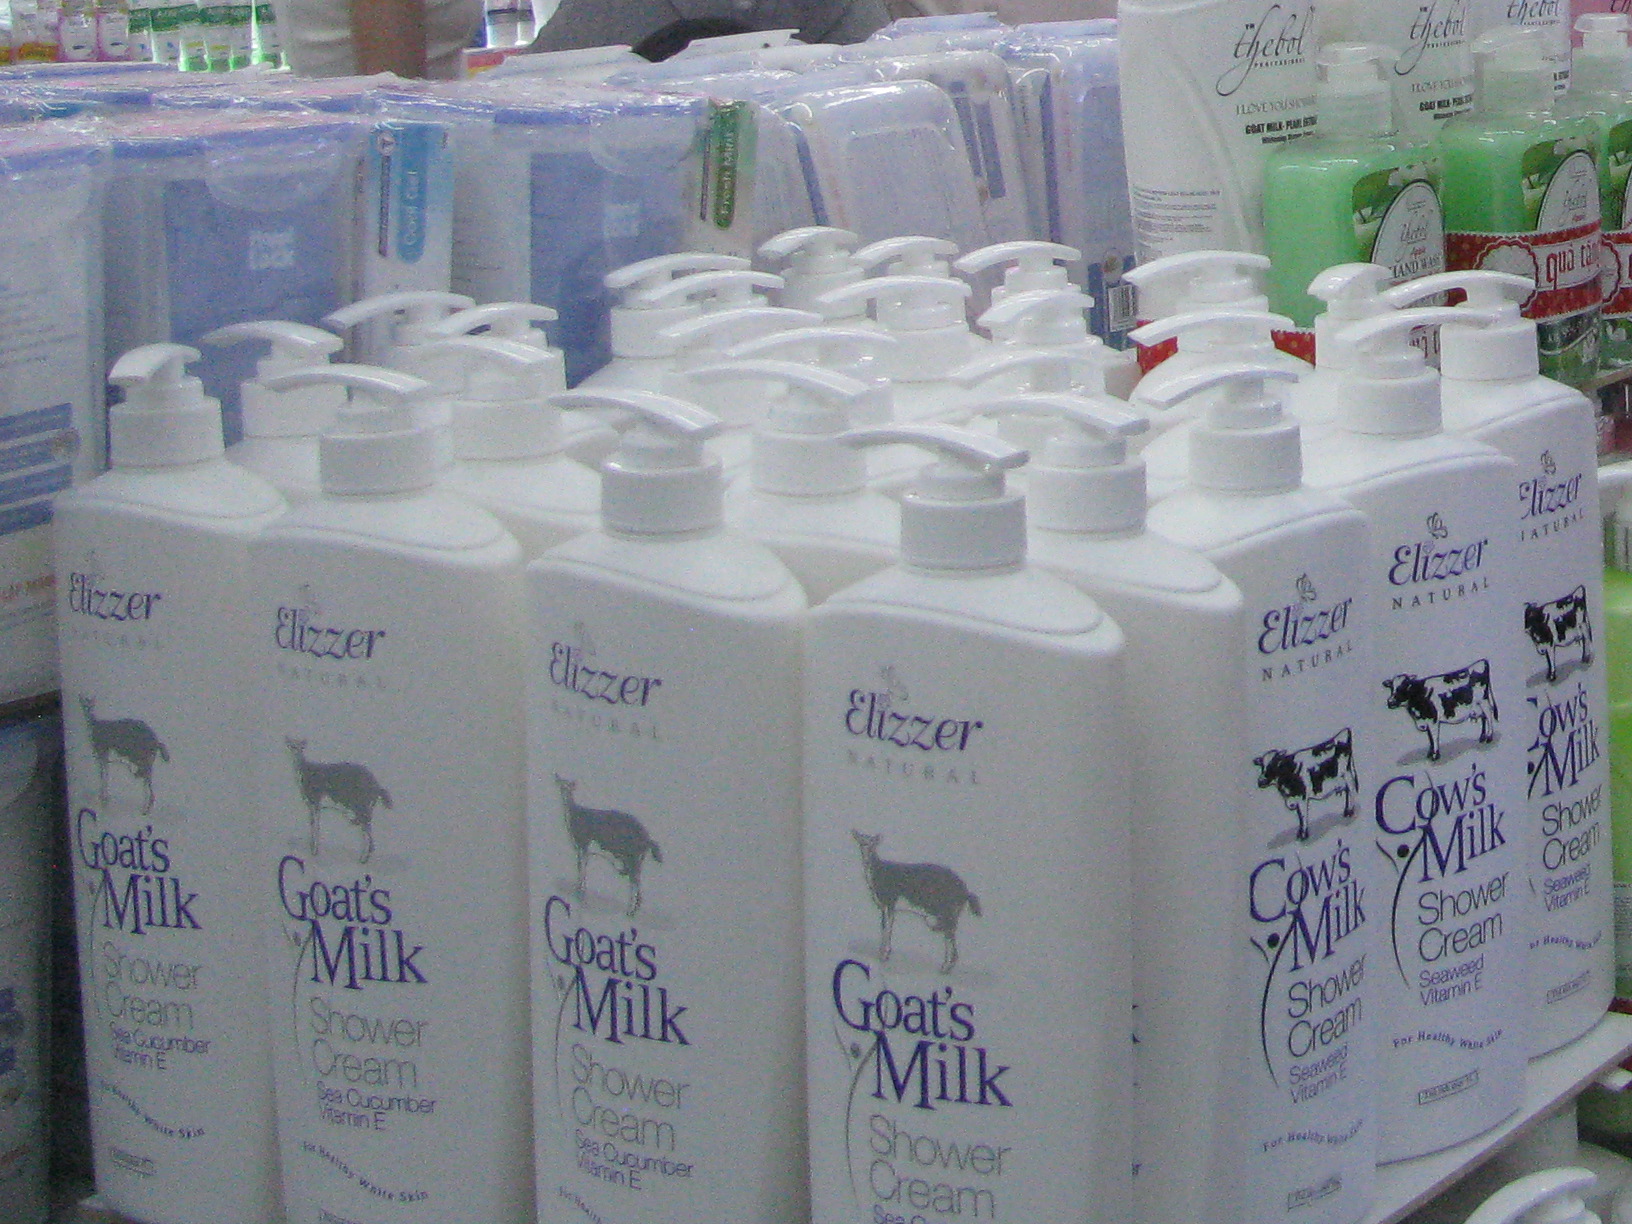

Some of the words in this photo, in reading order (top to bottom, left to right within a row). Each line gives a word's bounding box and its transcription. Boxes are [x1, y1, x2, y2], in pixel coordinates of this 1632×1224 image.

[1386, 534, 1490, 588] Elizzer
[69, 572, 163, 622] Elizzer
[1256, 591, 1355, 657] Elizzer
[1390, 575, 1491, 612] NATURAL
[275, 605, 386, 662] Elizzer
[1260, 639, 1355, 683] NATURAL
[548, 640, 664, 708] Elizzer
[844, 686, 985, 755] Elizzer
[847, 749, 981, 786] NATURAL
[1540, 717, 1601, 798] Milk
[1374, 762, 1487, 836] Cow's
[76, 807, 171, 874] Goat's
[1417, 802, 1507, 885] Milk
[102, 867, 203, 936] Milk
[278, 854, 393, 926] Goat's
[1248, 837, 1352, 924] Cow's
[1417, 871, 1510, 927] Shower
[309, 918, 429, 991] Milk
[543, 894, 658, 983] Goat's
[1288, 878, 1367, 974] Milk
[1418, 911, 1503, 964] Cream
[831, 958, 976, 1043] Goat's
[1287, 952, 1369, 1020] Shower
[1418, 952, 1485, 990] Seaweed
[1420, 980, 1472, 1008] Vitamin
[106, 979, 194, 1031] Cream
[309, 996, 428, 1049] Shower
[571, 964, 692, 1047] Milk
[1288, 995, 1363, 1059] Cream
[132, 1026, 212, 1056] Cucumber
[156, 1050, 168, 1072] E
[312, 1036, 419, 1089] Cream
[870, 1028, 1014, 1112] Milk
[1289, 1040, 1349, 1086] Seaweed
[346, 1087, 438, 1115] Cucumber
[571, 1042, 691, 1110] Shower
[1290, 1073, 1338, 1106] Vitamin
[374, 1110, 387, 1132] E
[572, 1084, 676, 1152] Cream
[868, 1113, 1012, 1177] Shower
[602, 1141, 695, 1178] Cucumber
[628, 1168, 643, 1191] E
[868, 1159, 998, 1223] Cream
